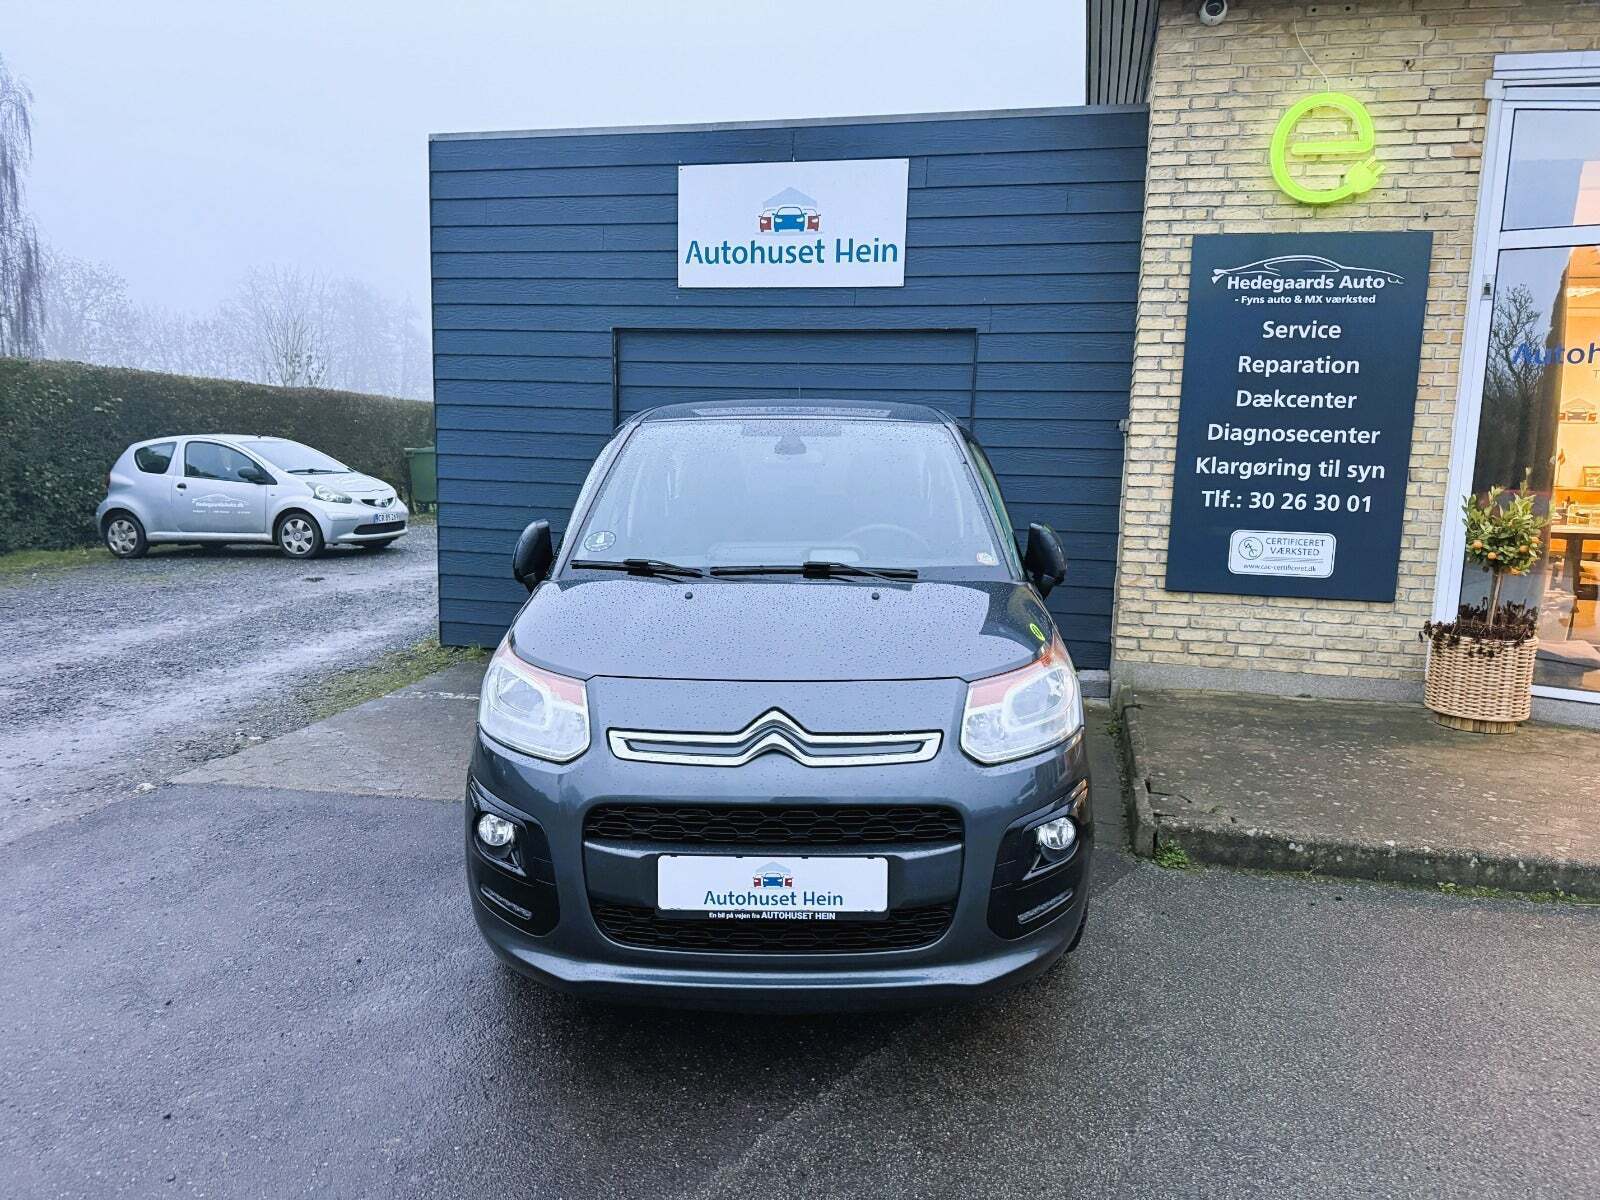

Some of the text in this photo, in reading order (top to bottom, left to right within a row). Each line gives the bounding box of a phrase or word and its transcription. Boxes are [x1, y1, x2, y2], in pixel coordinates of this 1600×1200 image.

[685, 237, 898, 265] Autohuset Hein
[1227, 275, 1386, 293] Hedegaards Auto
[1241, 295, 1265, 306] Fyns
[1267, 295, 1292, 304] auto
[1294, 295, 1303, 304] &
[1304, 295, 1323, 304] MX
[1325, 294, 1377, 305] værksted
[1262, 320, 1342, 339] Service
[1238, 355, 1360, 377] Reparation
[1236, 389, 1358, 409] Dækcenter
[1207, 423, 1381, 446] Diagnosecenter
[1195, 456, 1386, 483] Klargøring til syn
[1202, 490, 1373, 513] Tlf.: 30 26 30 01
[1265, 537, 1326, 548] CERTIFICERET
[1270, 547, 1320, 557] VÆRKSTED
[703, 890, 844, 906] Autohuset Hein
[726, 911, 734, 920] på
[734, 912, 751, 920] vejen
[761, 911, 814, 920] AUTOHUSET
[815, 912, 836, 920] HEIN
